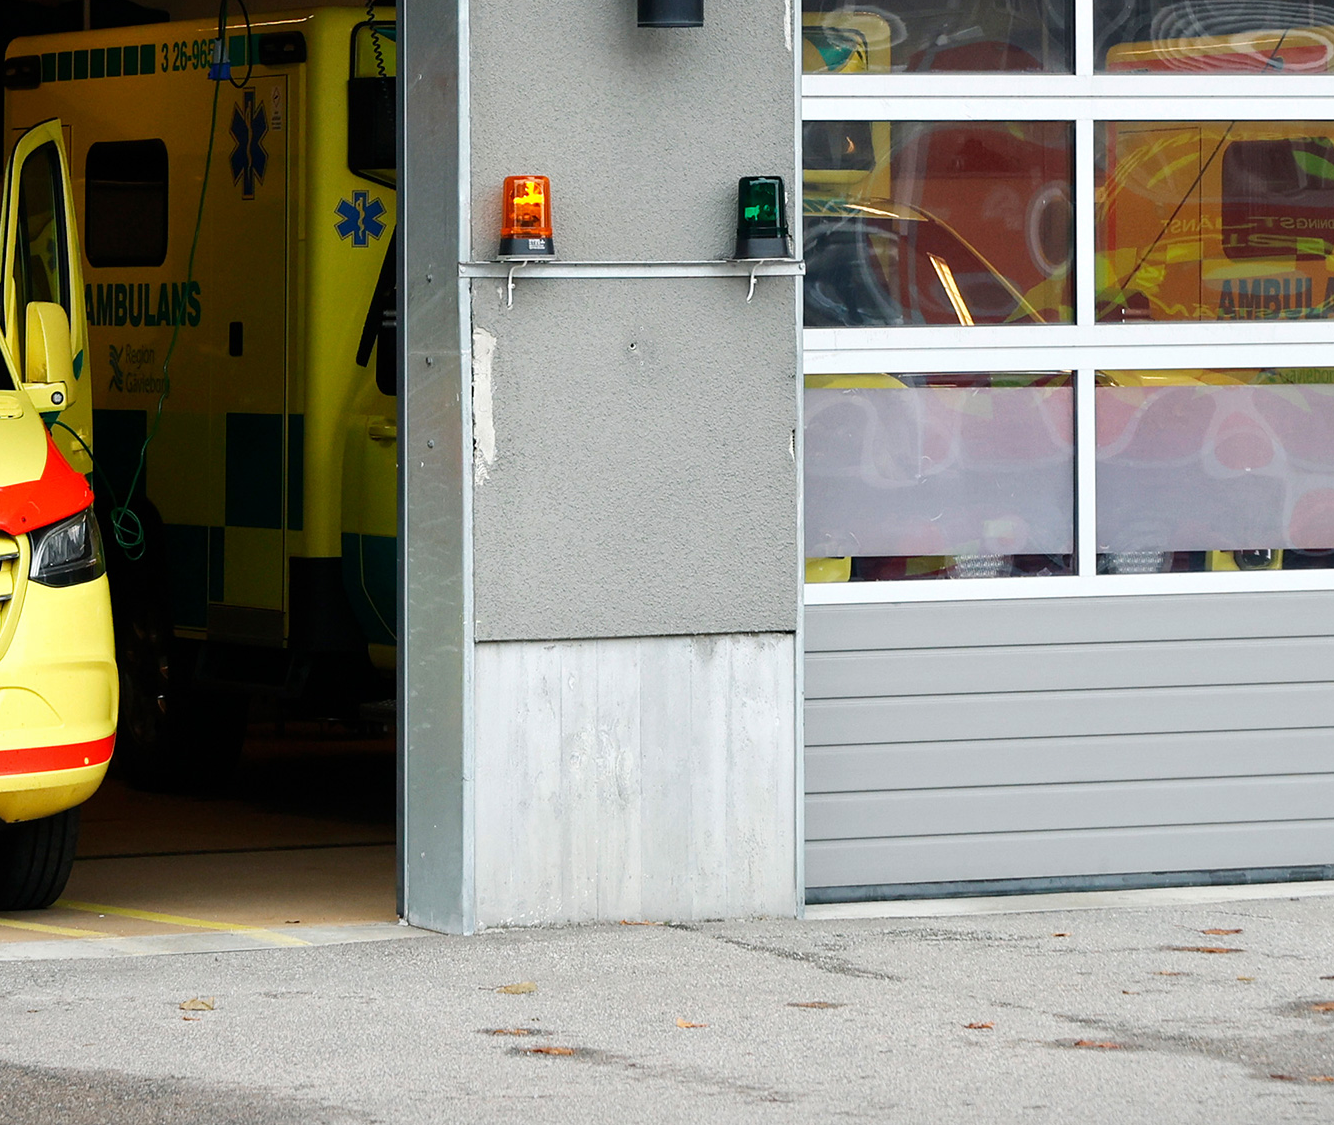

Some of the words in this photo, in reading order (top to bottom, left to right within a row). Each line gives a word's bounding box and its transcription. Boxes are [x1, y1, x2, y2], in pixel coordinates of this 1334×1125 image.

[161, 43, 169, 73] 3
[85, 281, 201, 327] AMBULANS
[126, 344, 155, 369] Region
